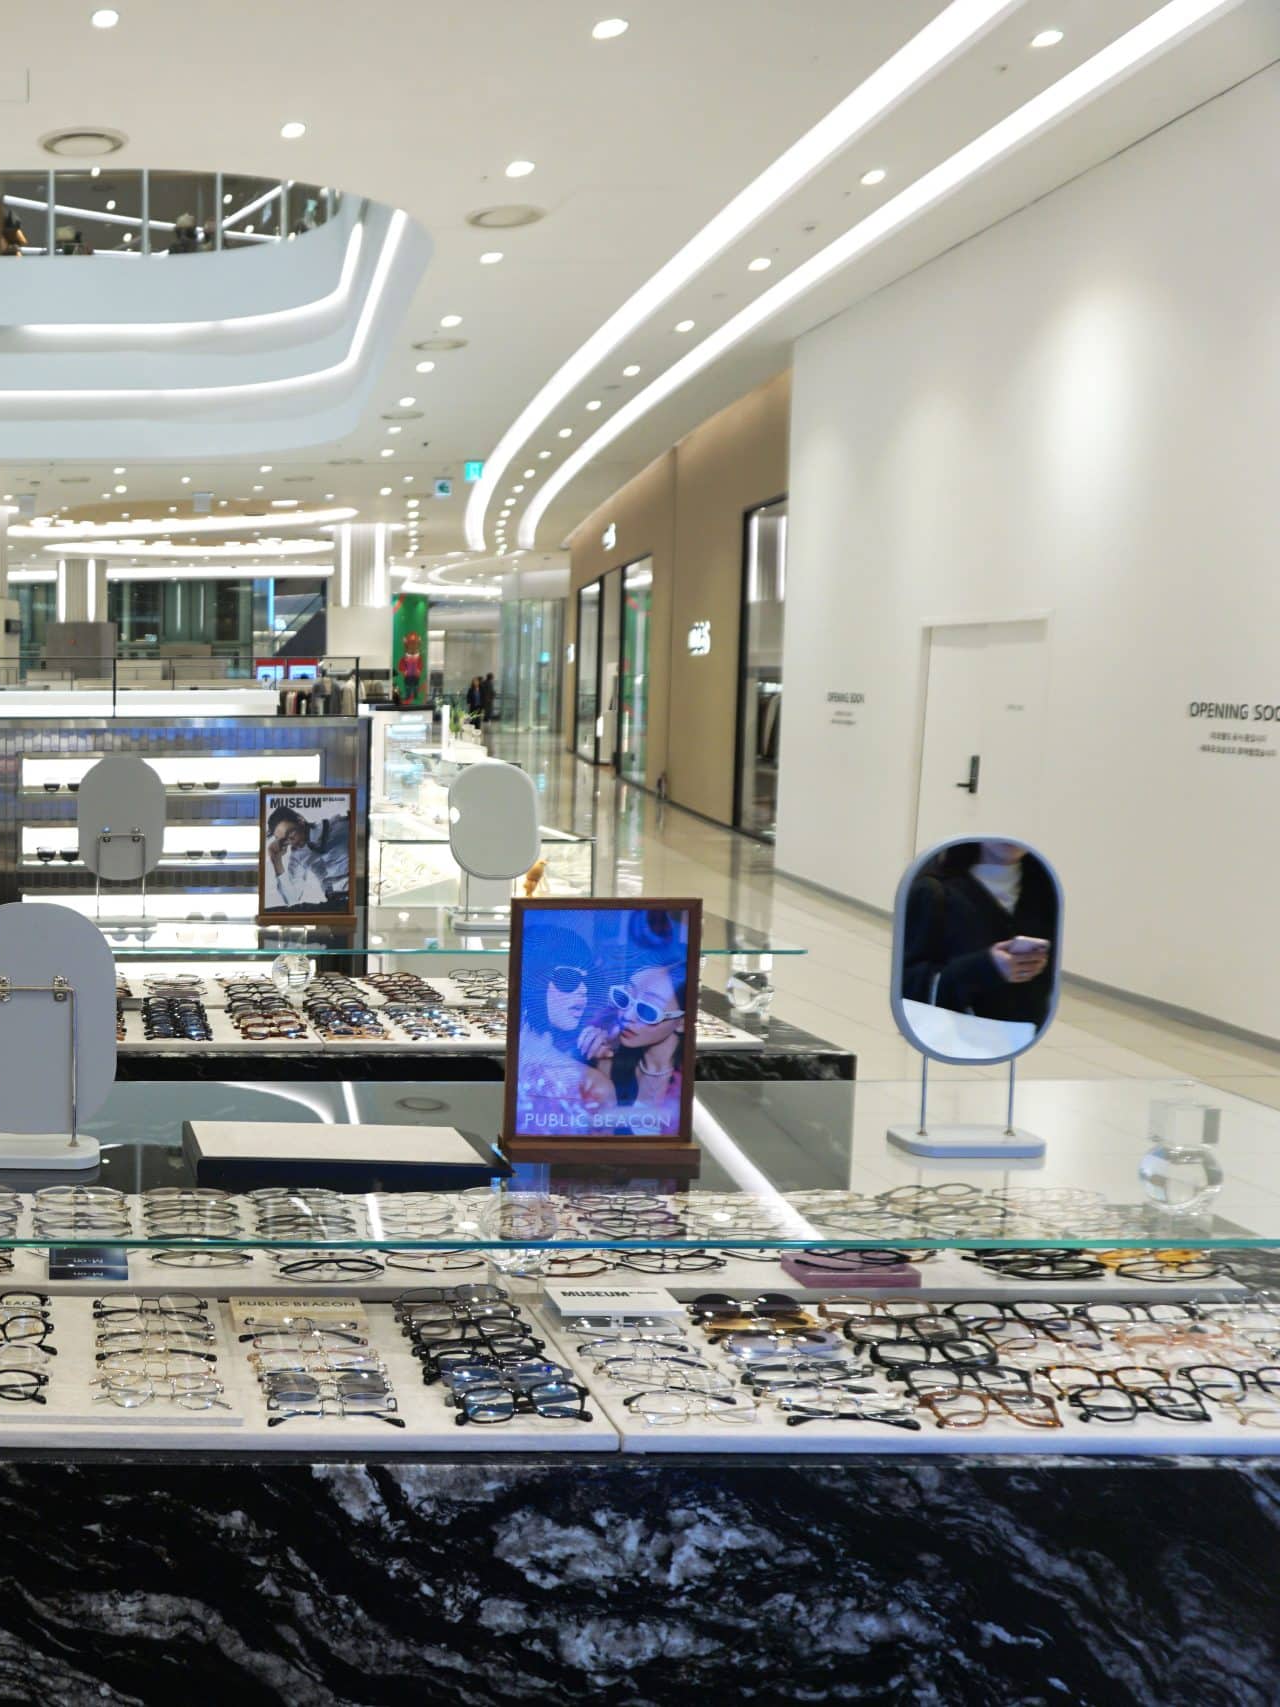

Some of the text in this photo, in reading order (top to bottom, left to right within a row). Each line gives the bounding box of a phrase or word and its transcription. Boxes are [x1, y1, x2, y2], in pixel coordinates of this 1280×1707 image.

[1190, 701, 1249, 720] OPENING
[269, 797, 322, 809] MUSEUM
[525, 1112, 671, 1129] PUBLIC BEACON
